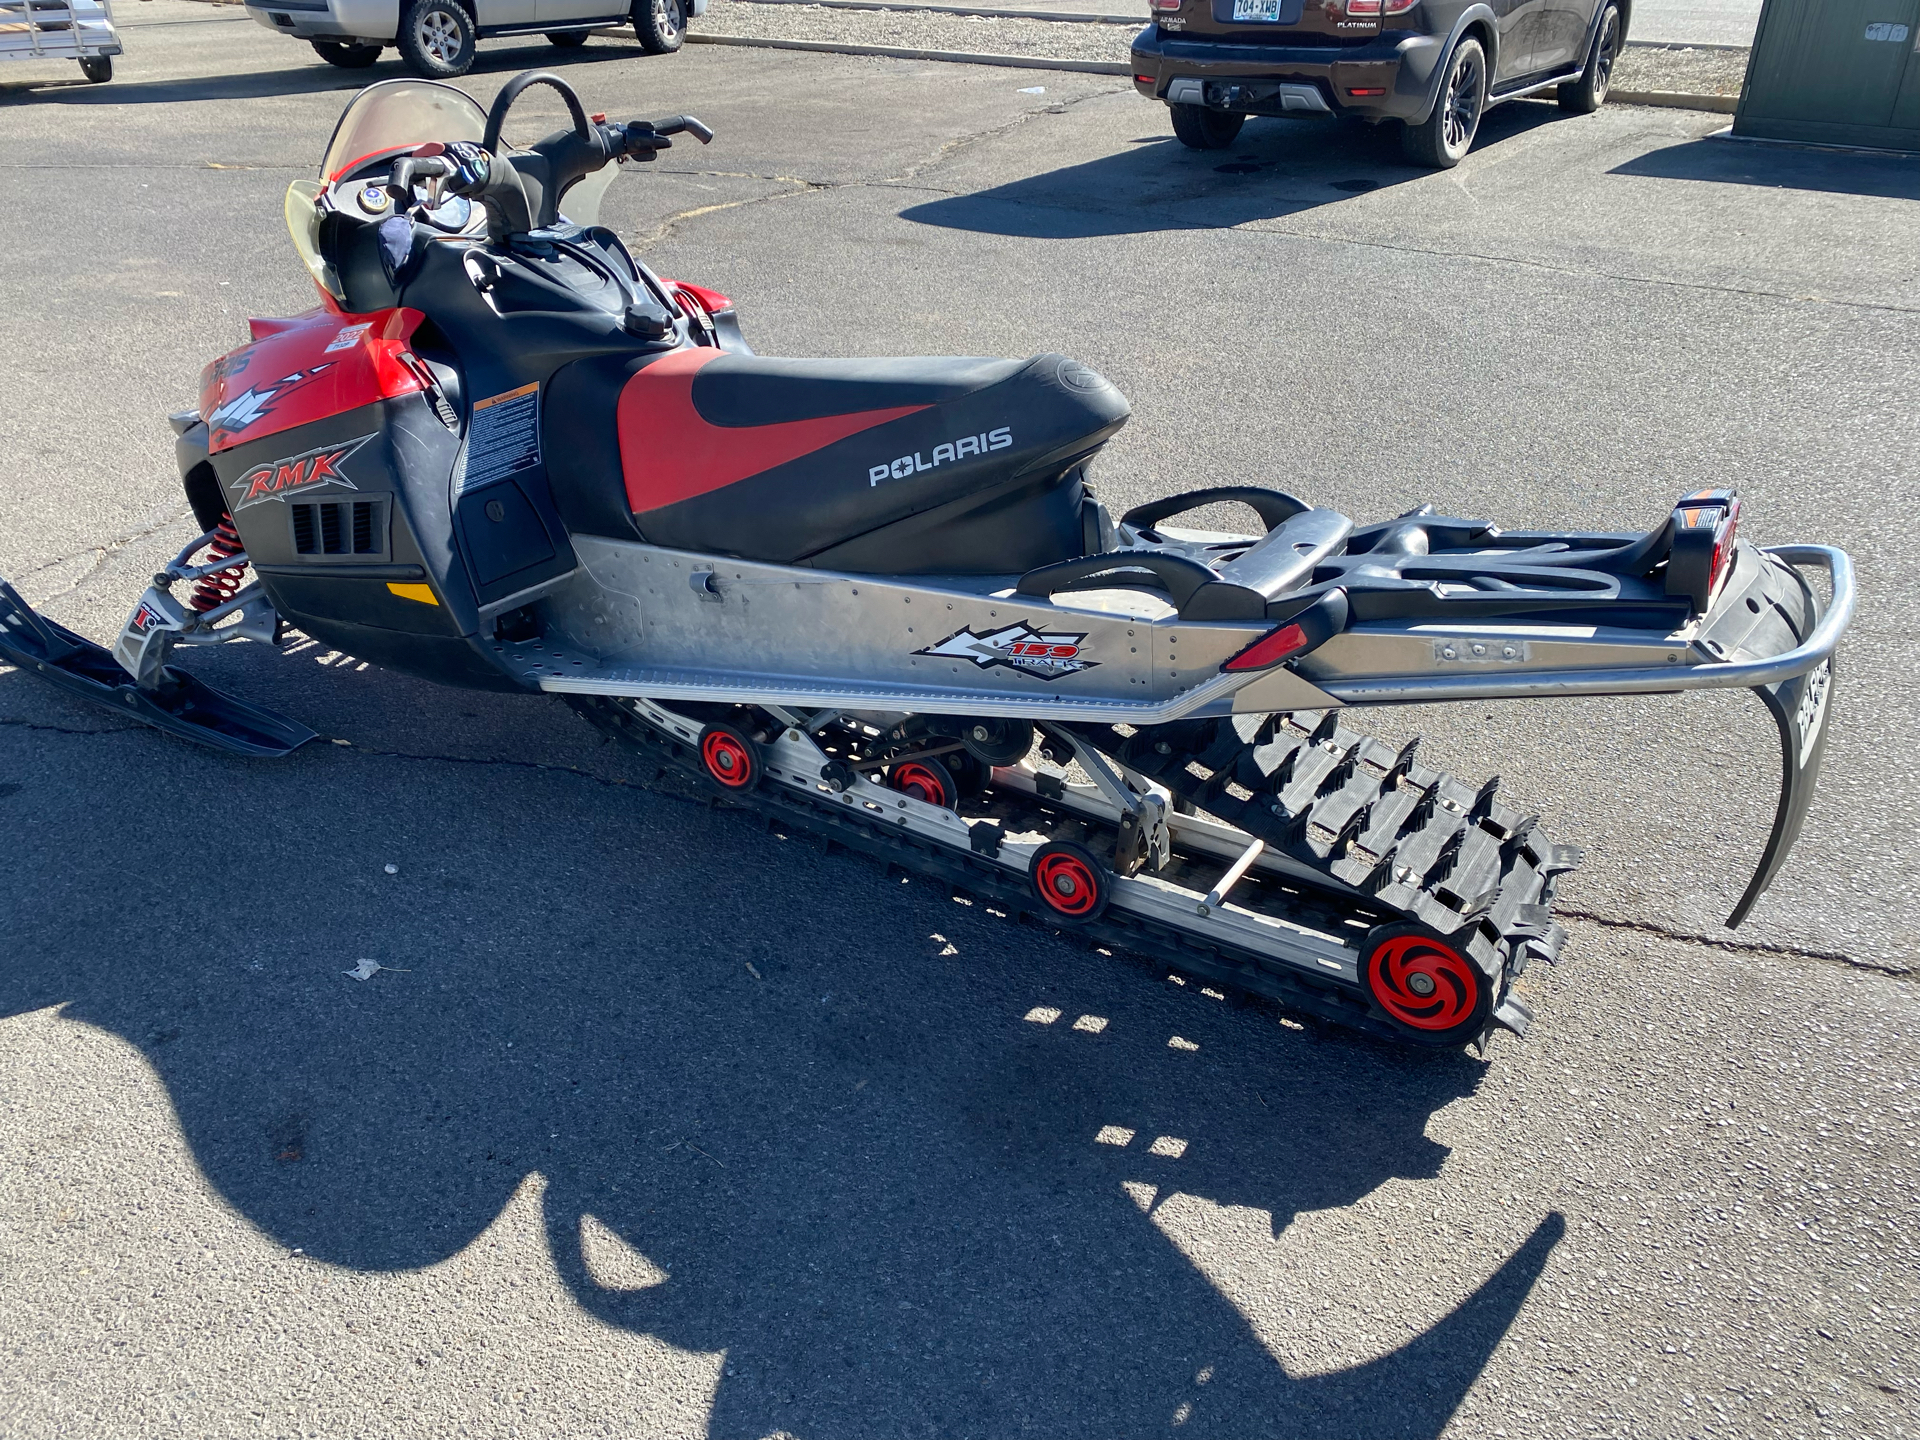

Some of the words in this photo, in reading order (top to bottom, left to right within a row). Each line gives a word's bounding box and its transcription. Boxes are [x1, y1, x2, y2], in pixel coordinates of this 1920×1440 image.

[1160, 16, 1187, 24] ARMADA
[332, 330, 364, 343] 2022
[868, 426, 1013, 487] POLARIS
[246, 449, 348, 500] RMK
[1011, 642, 1079, 658] 159
[1012, 656, 1078, 671] TRACK
